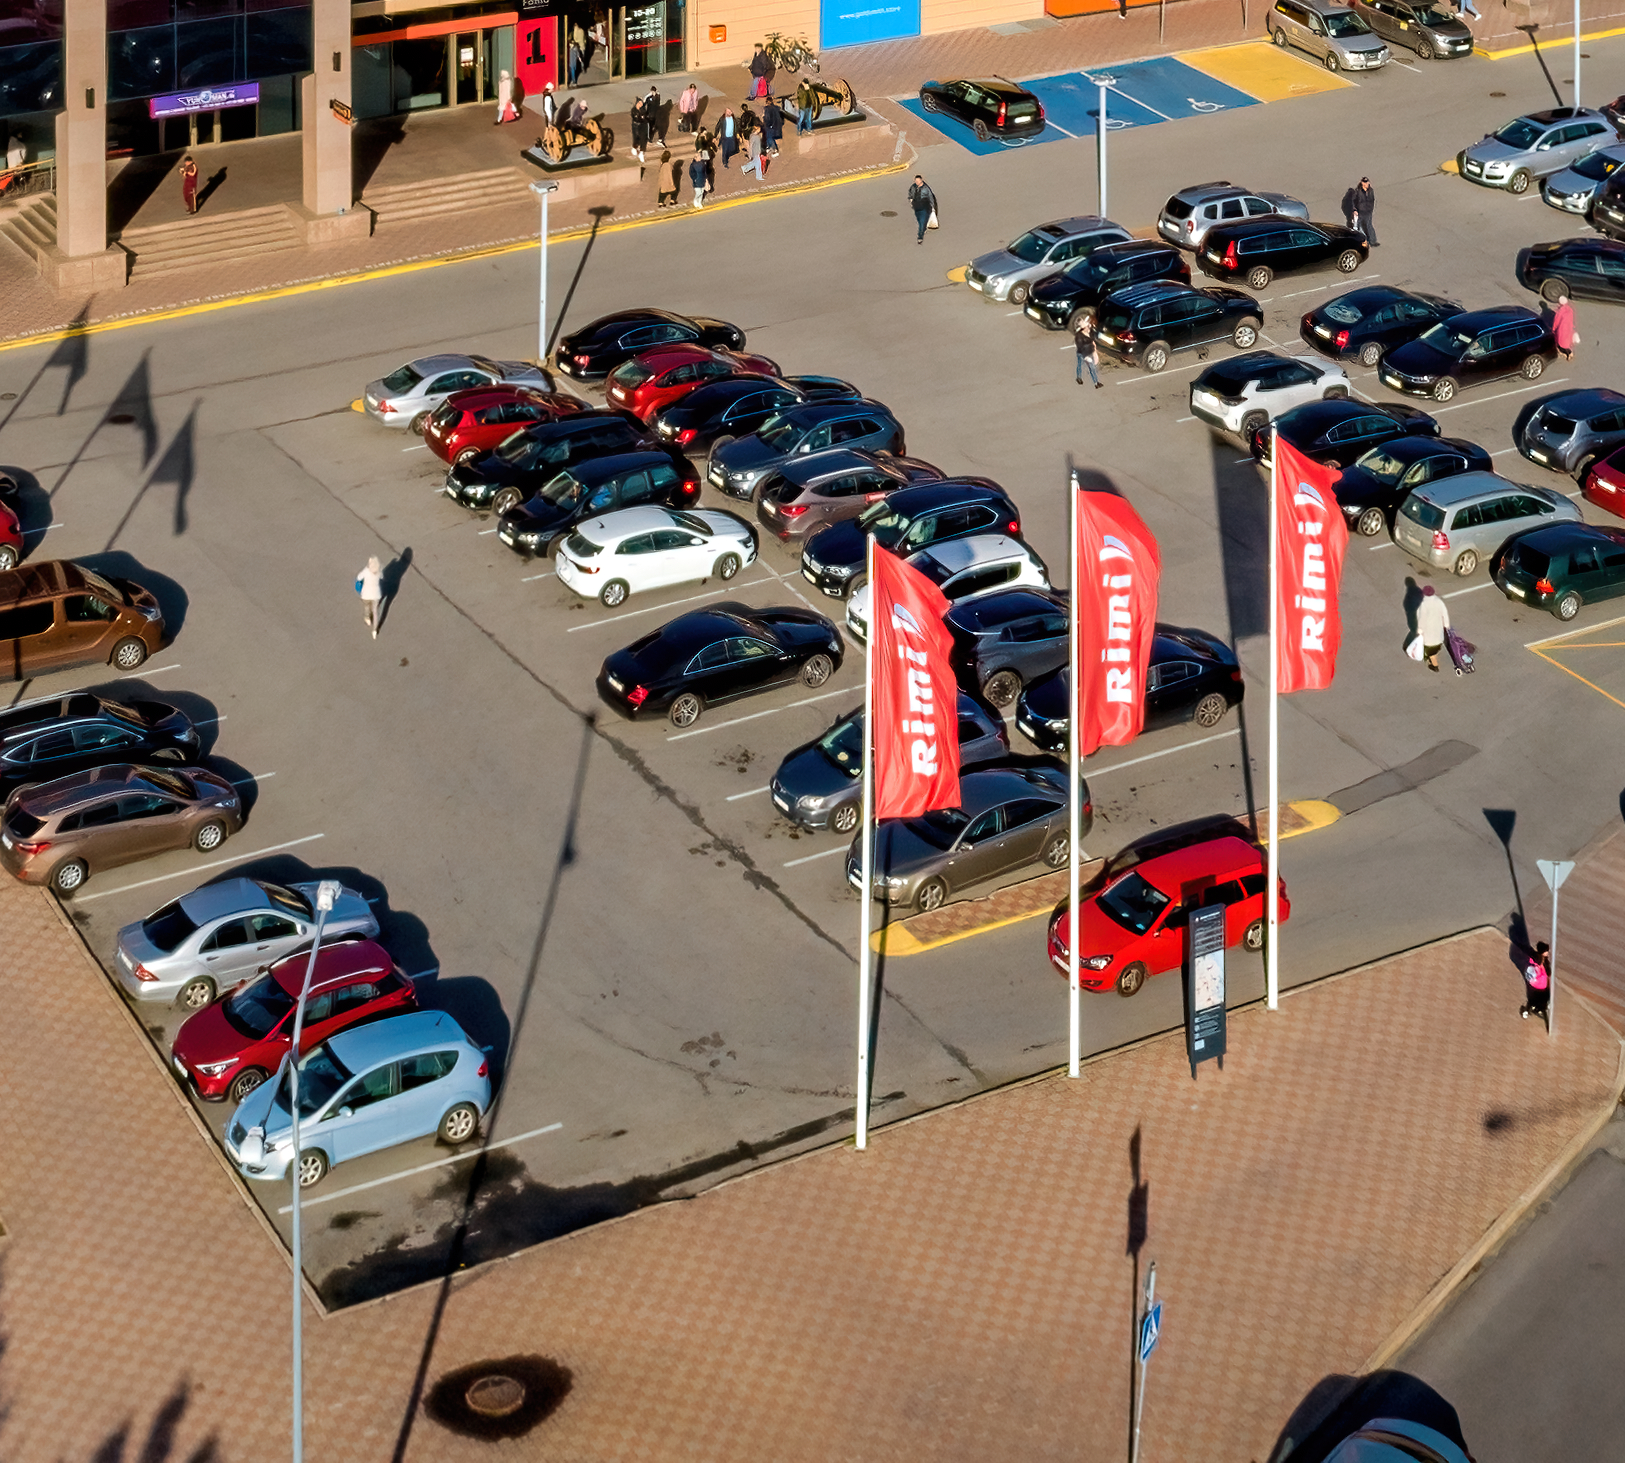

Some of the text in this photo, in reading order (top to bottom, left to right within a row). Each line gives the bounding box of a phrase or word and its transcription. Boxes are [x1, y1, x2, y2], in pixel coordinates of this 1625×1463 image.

[526, 27, 546, 65] 1
[1102, 572, 1133, 704] Rimi
[1295, 521, 1326, 653] Rimi
[898, 643, 939, 777] Rimi
